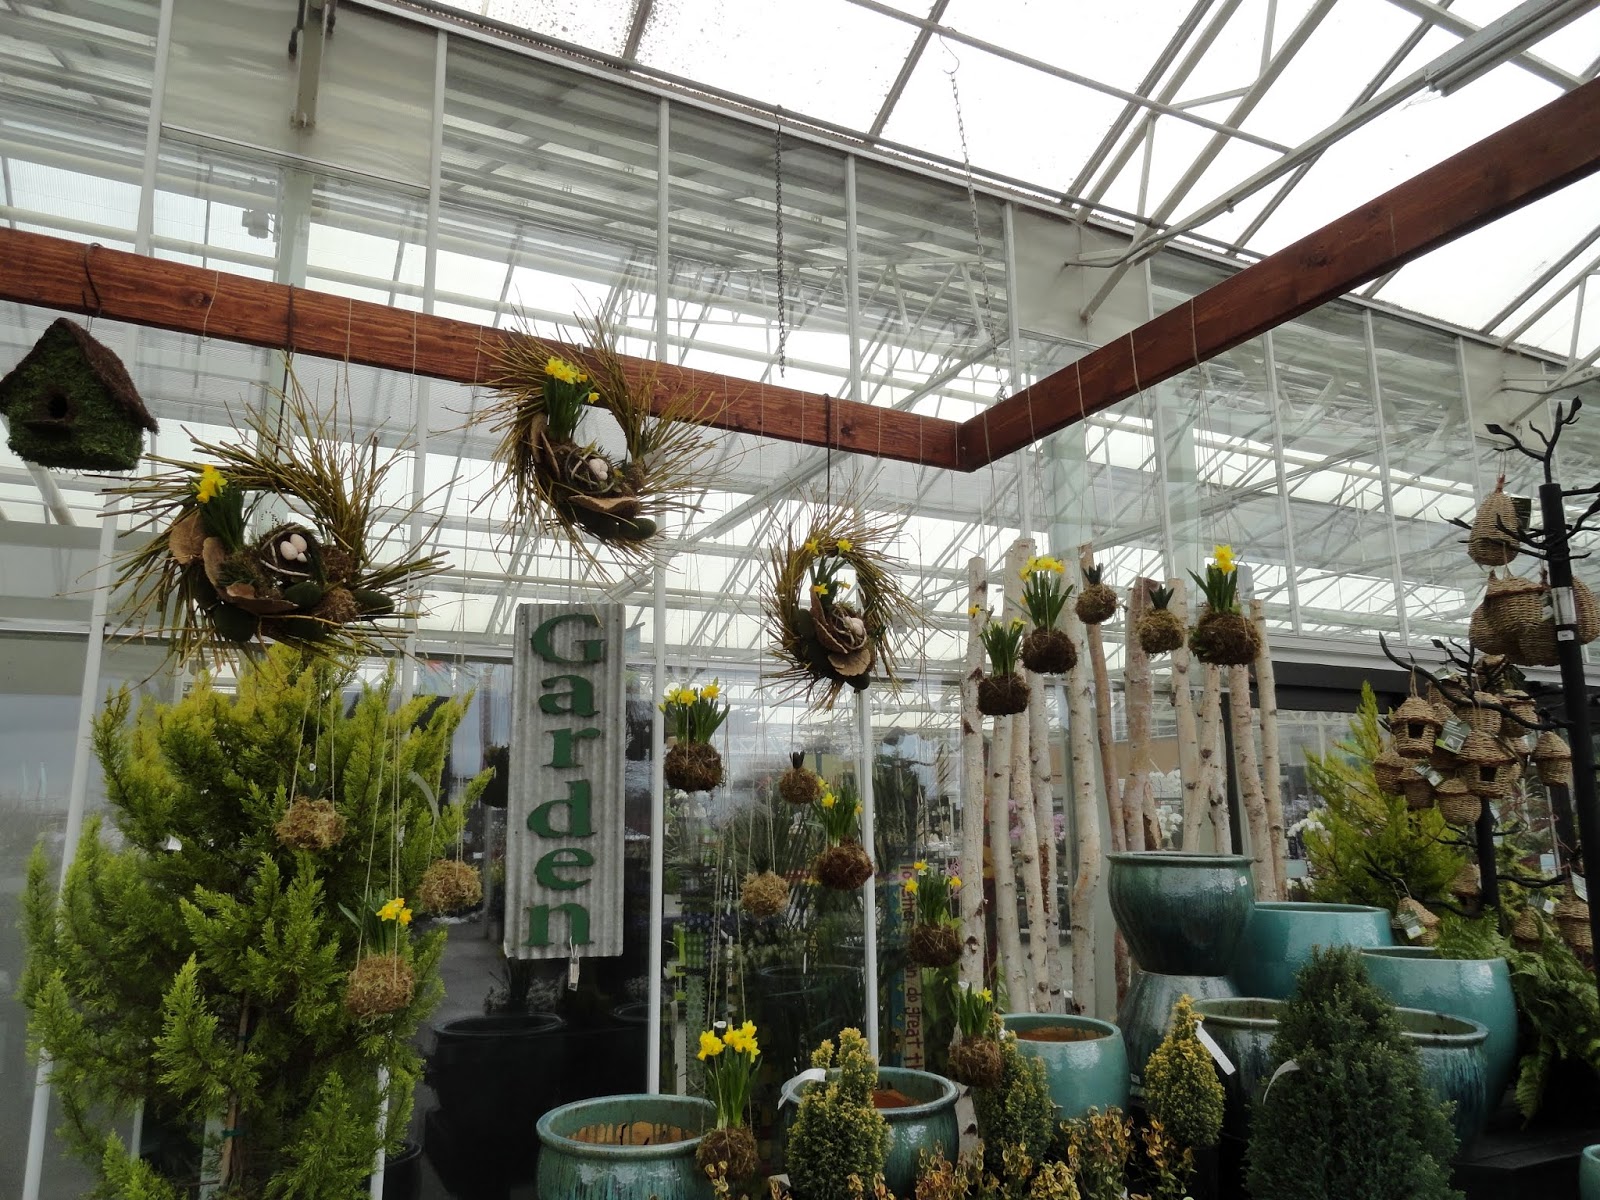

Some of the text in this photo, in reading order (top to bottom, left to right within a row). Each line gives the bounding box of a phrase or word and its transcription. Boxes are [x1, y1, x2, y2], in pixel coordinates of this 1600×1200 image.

[522, 612, 606, 947] Garden
[900, 865, 917, 923] Toether
[907, 987, 921, 1002] do
[904, 1007, 923, 1049] great
